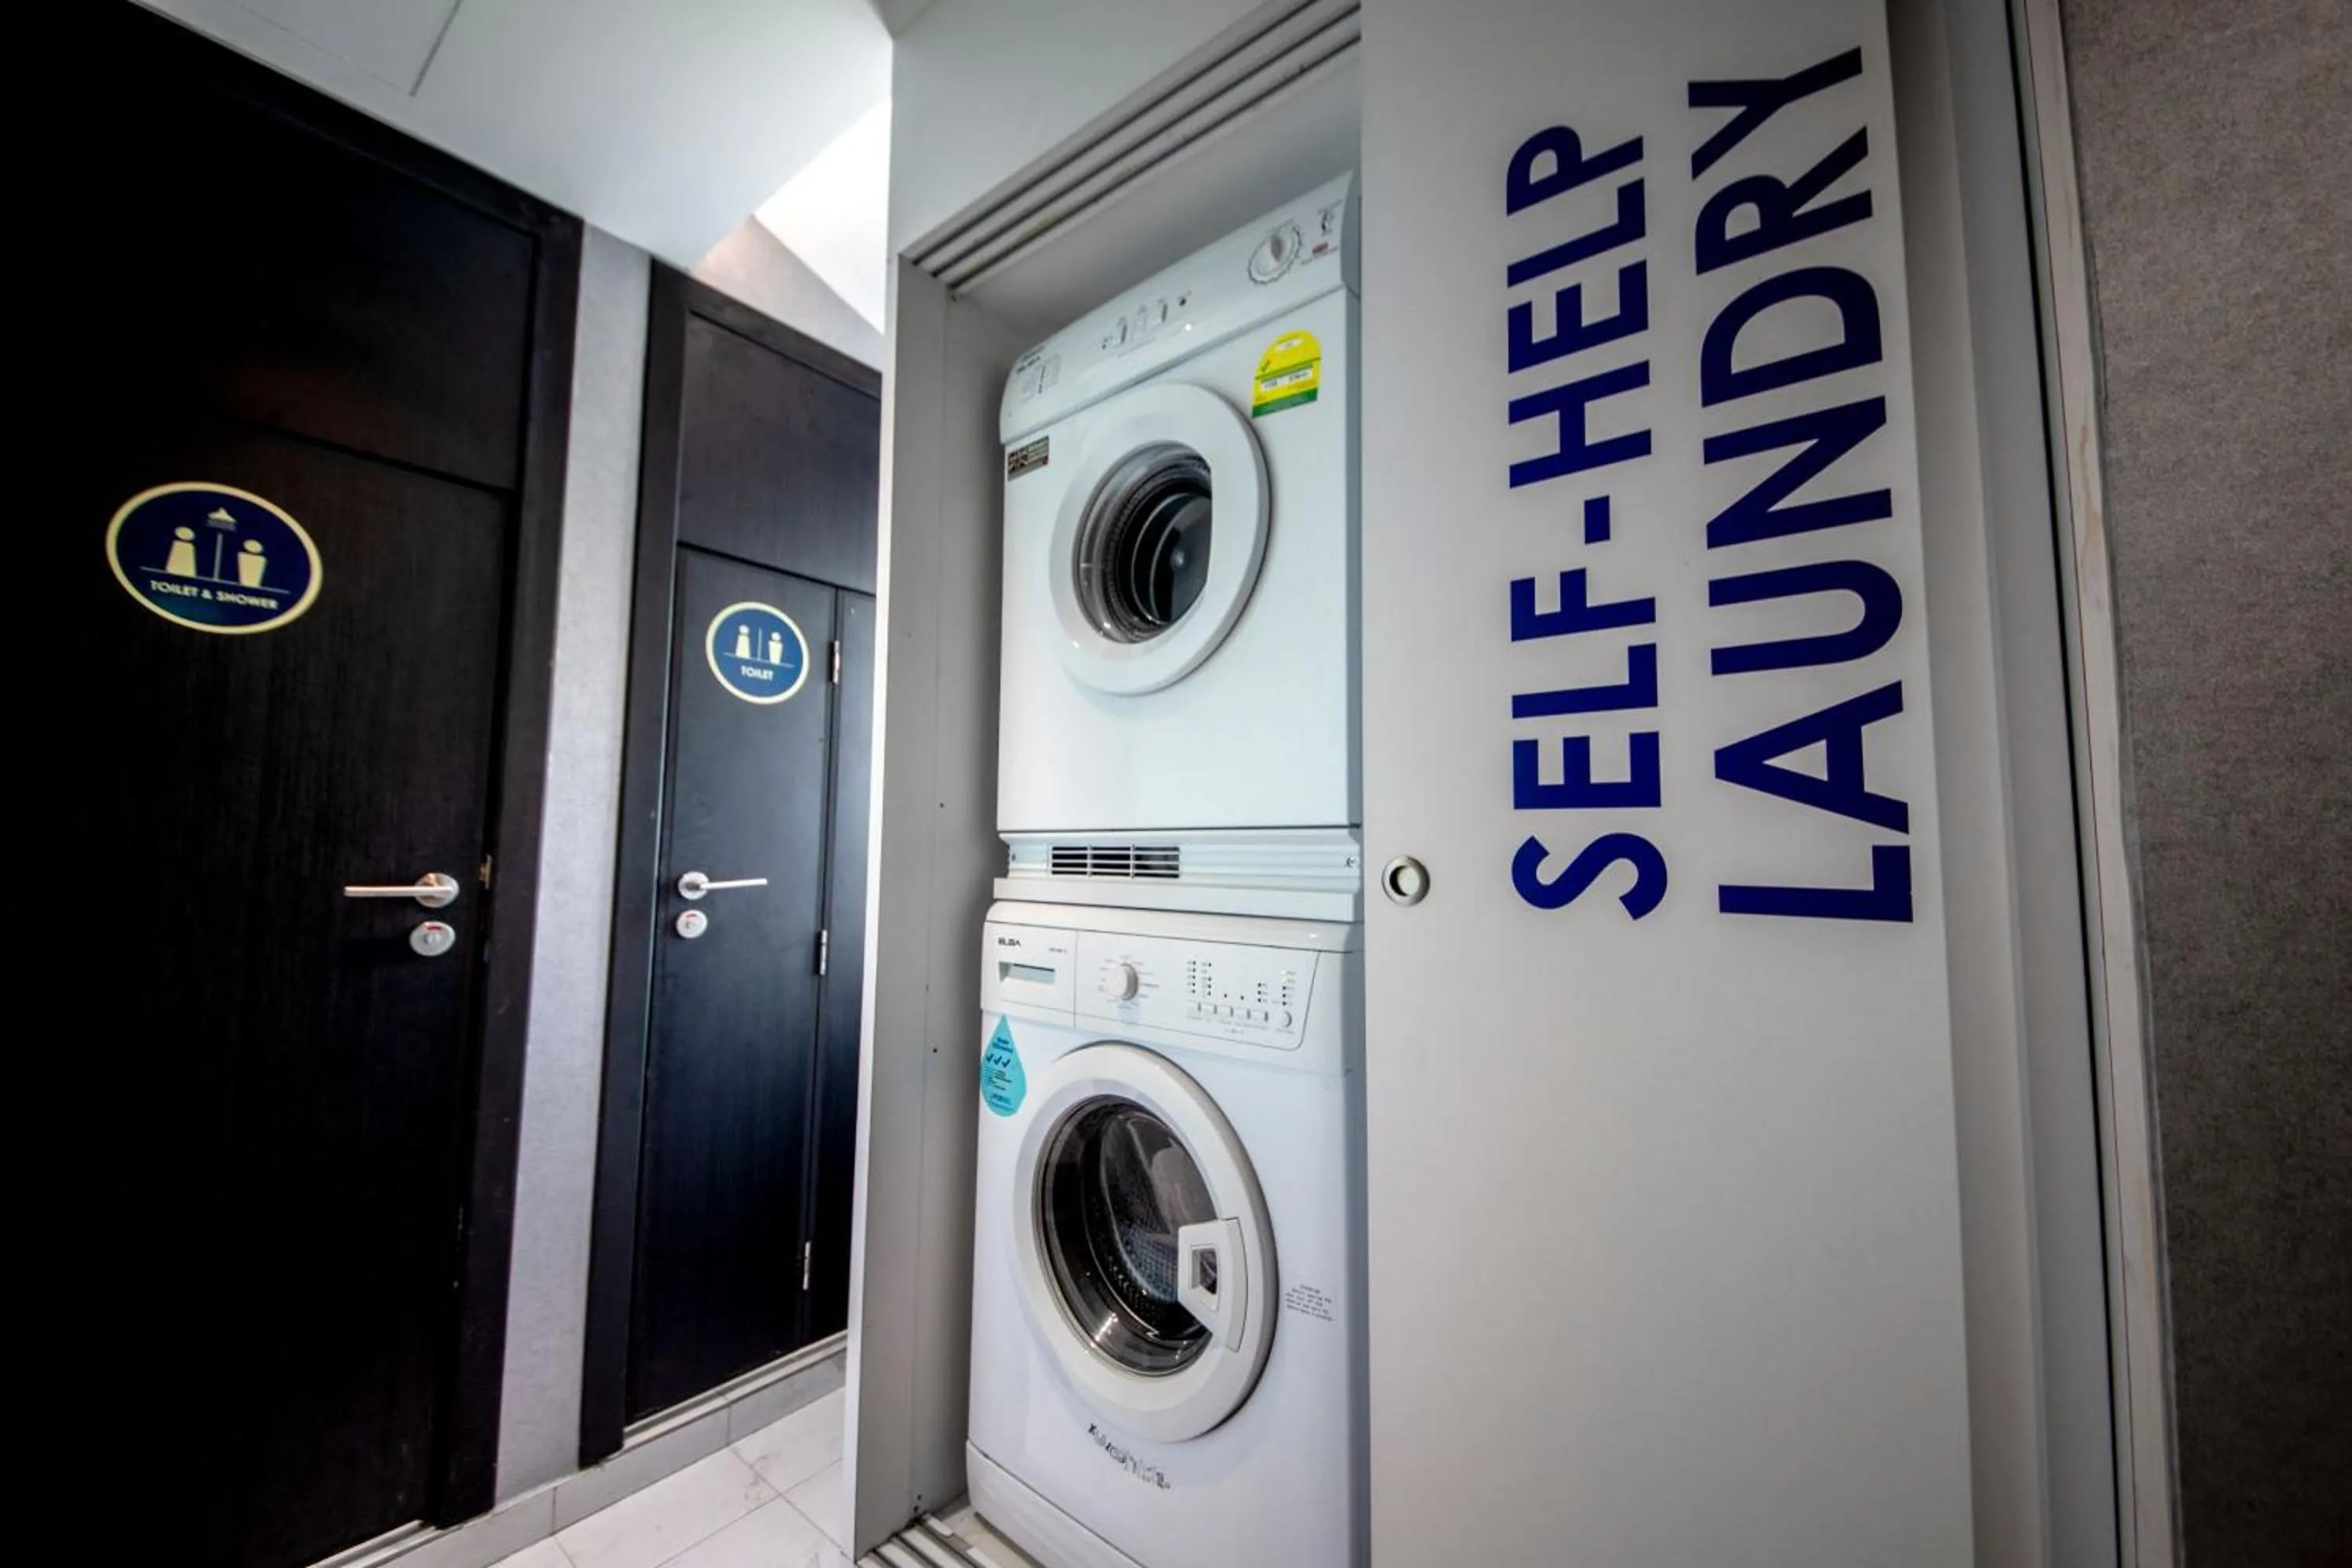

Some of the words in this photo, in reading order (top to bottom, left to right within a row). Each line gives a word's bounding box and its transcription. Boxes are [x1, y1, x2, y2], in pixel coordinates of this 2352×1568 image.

[150, 579, 199, 597] TOILET
[201, 589, 212, 601] &
[216, 590, 278, 609] SHOWER
[741, 666, 774, 681] TOILET
[1506, 125, 1668, 920] SELF-HELP
[1688, 45, 1914, 924] LAUNDRY
